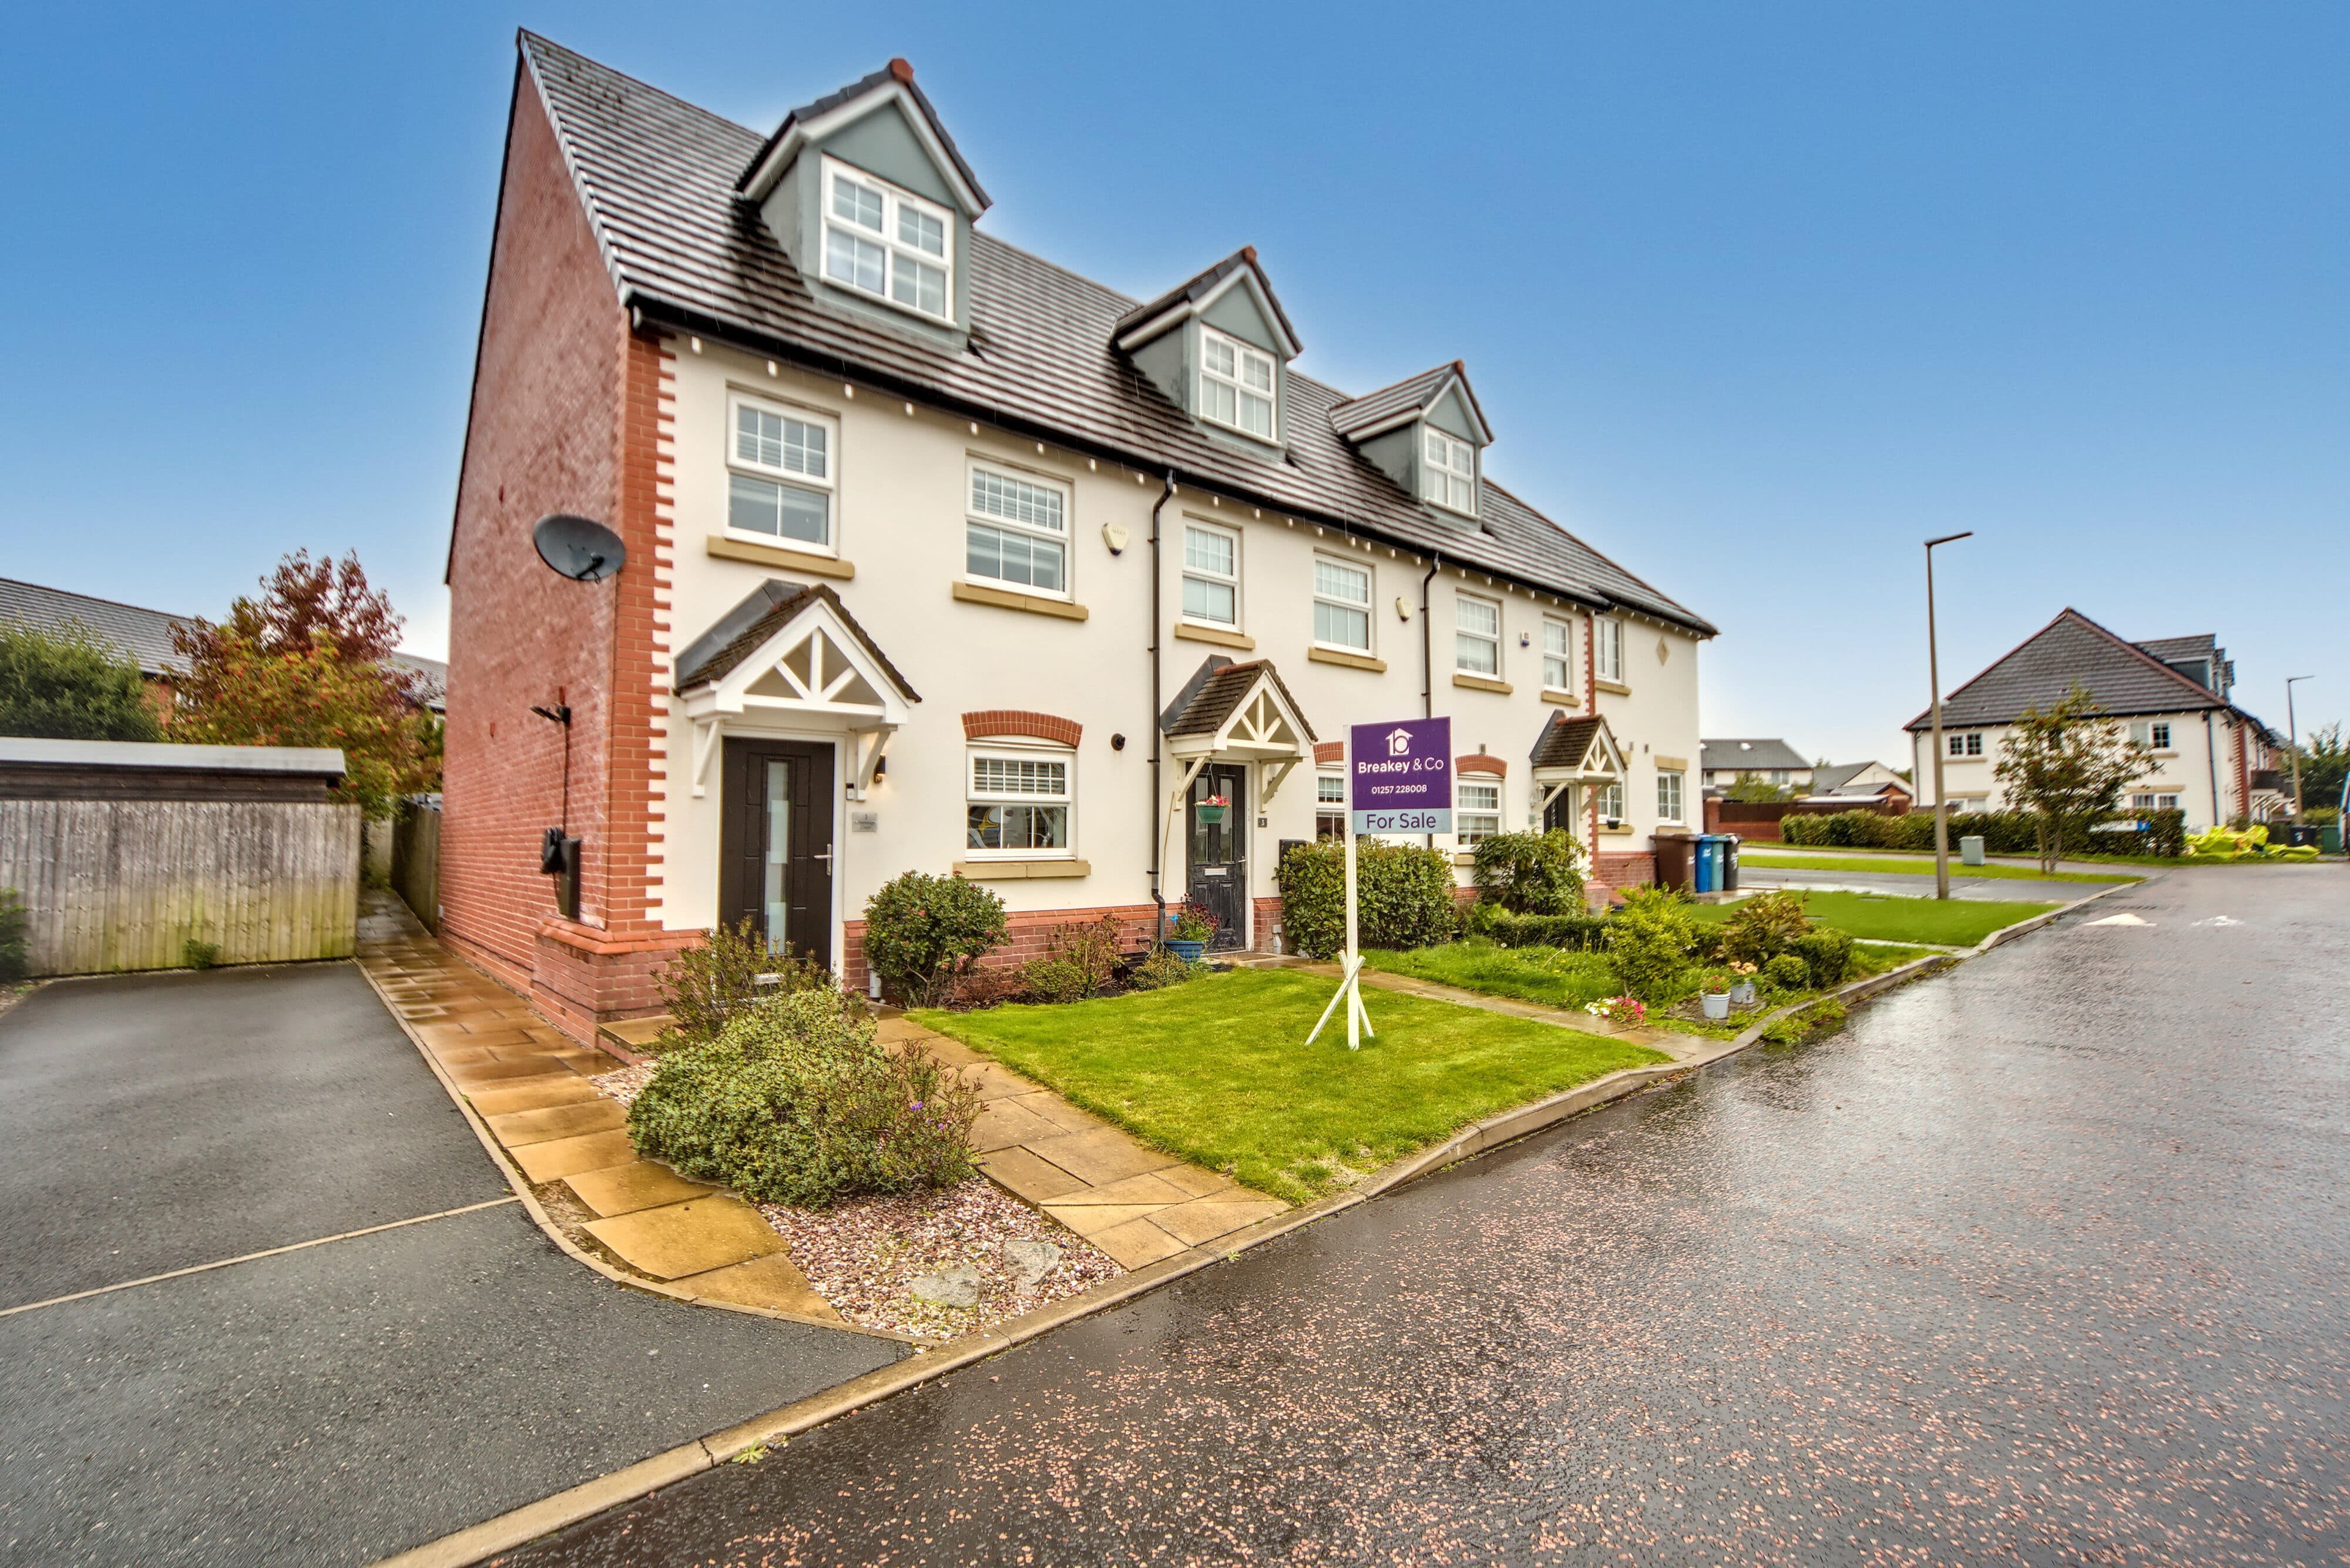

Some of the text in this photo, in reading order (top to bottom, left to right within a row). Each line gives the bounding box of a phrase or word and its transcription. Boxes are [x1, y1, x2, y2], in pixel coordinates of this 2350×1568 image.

[1358, 757, 1444, 774] Breakey & Co
[1372, 785, 1427, 794] 01257 228008
[1367, 812, 1436, 829] For Sale
